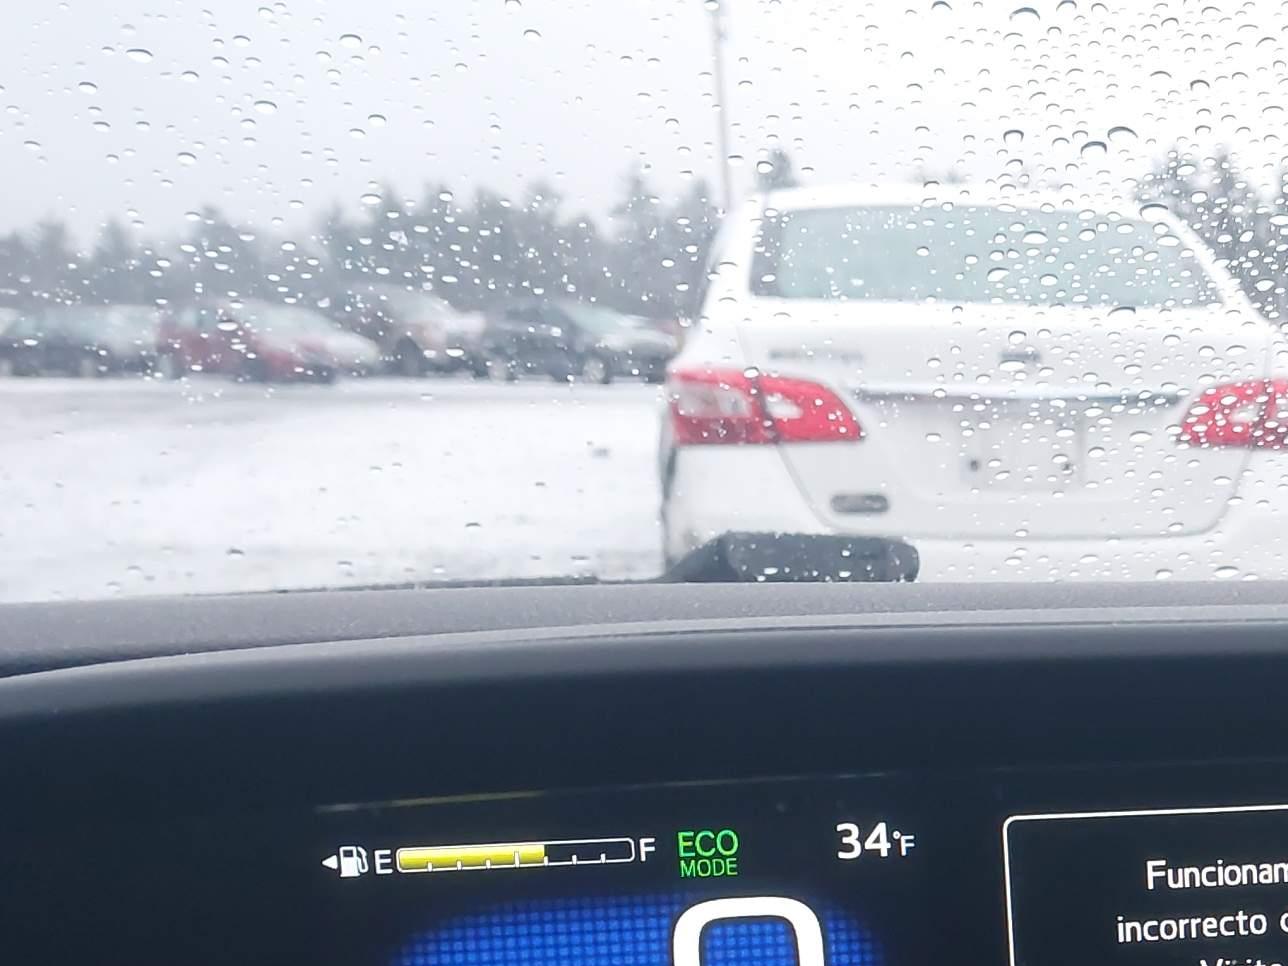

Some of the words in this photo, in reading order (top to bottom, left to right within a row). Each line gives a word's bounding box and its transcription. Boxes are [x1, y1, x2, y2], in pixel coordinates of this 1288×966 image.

[639, 838, 656, 861] F
[677, 830, 739, 858] ECO
[375, 850, 393, 875] E
[679, 858, 739, 877] MODE
[1117, 911, 1268, 943] incorrecto
